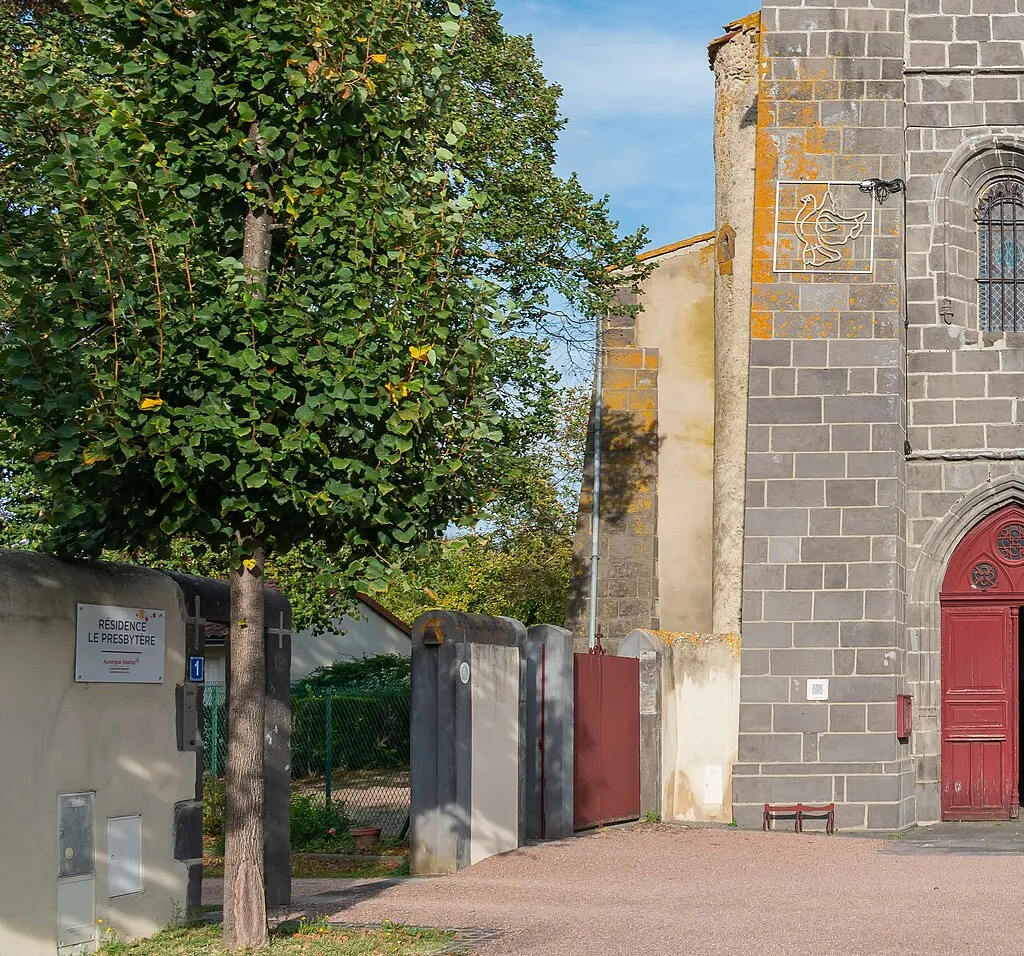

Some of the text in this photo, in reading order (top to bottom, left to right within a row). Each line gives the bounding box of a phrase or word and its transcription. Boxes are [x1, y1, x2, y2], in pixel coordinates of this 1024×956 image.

[98, 617, 147, 632] RÉSIDENCE
[88, 632, 156, 646] LE PRESBYTÈRE
